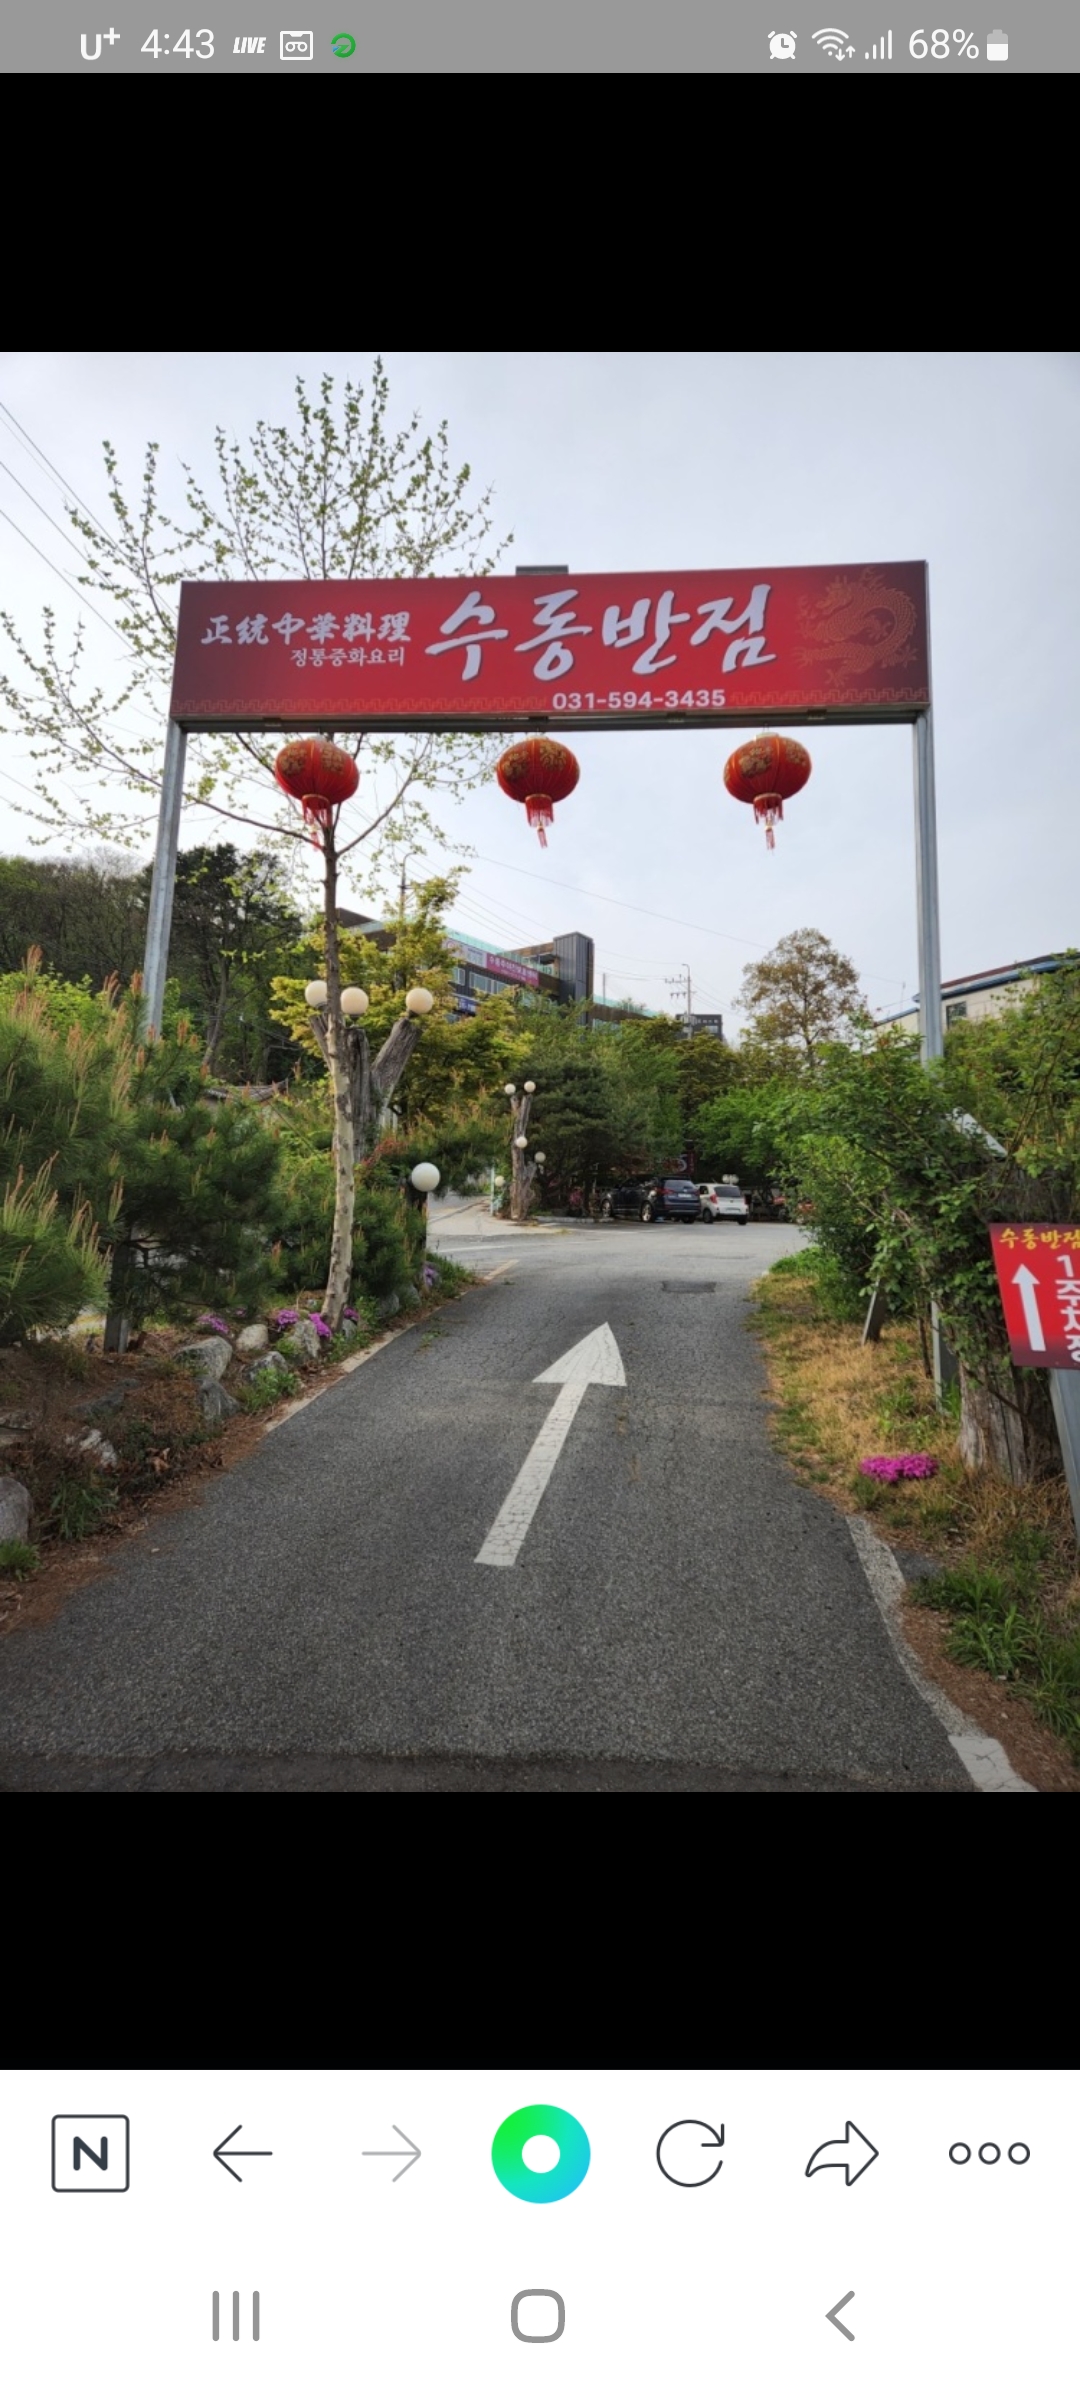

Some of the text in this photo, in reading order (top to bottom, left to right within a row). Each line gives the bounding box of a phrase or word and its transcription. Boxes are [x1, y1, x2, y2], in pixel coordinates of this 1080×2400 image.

[201, 611, 412, 645] 正統中華料理
[425, 583, 777, 681] 수동반점
[290, 647, 405, 668] 정통중화요리
[552, 688, 726, 711] 031-594-3435
